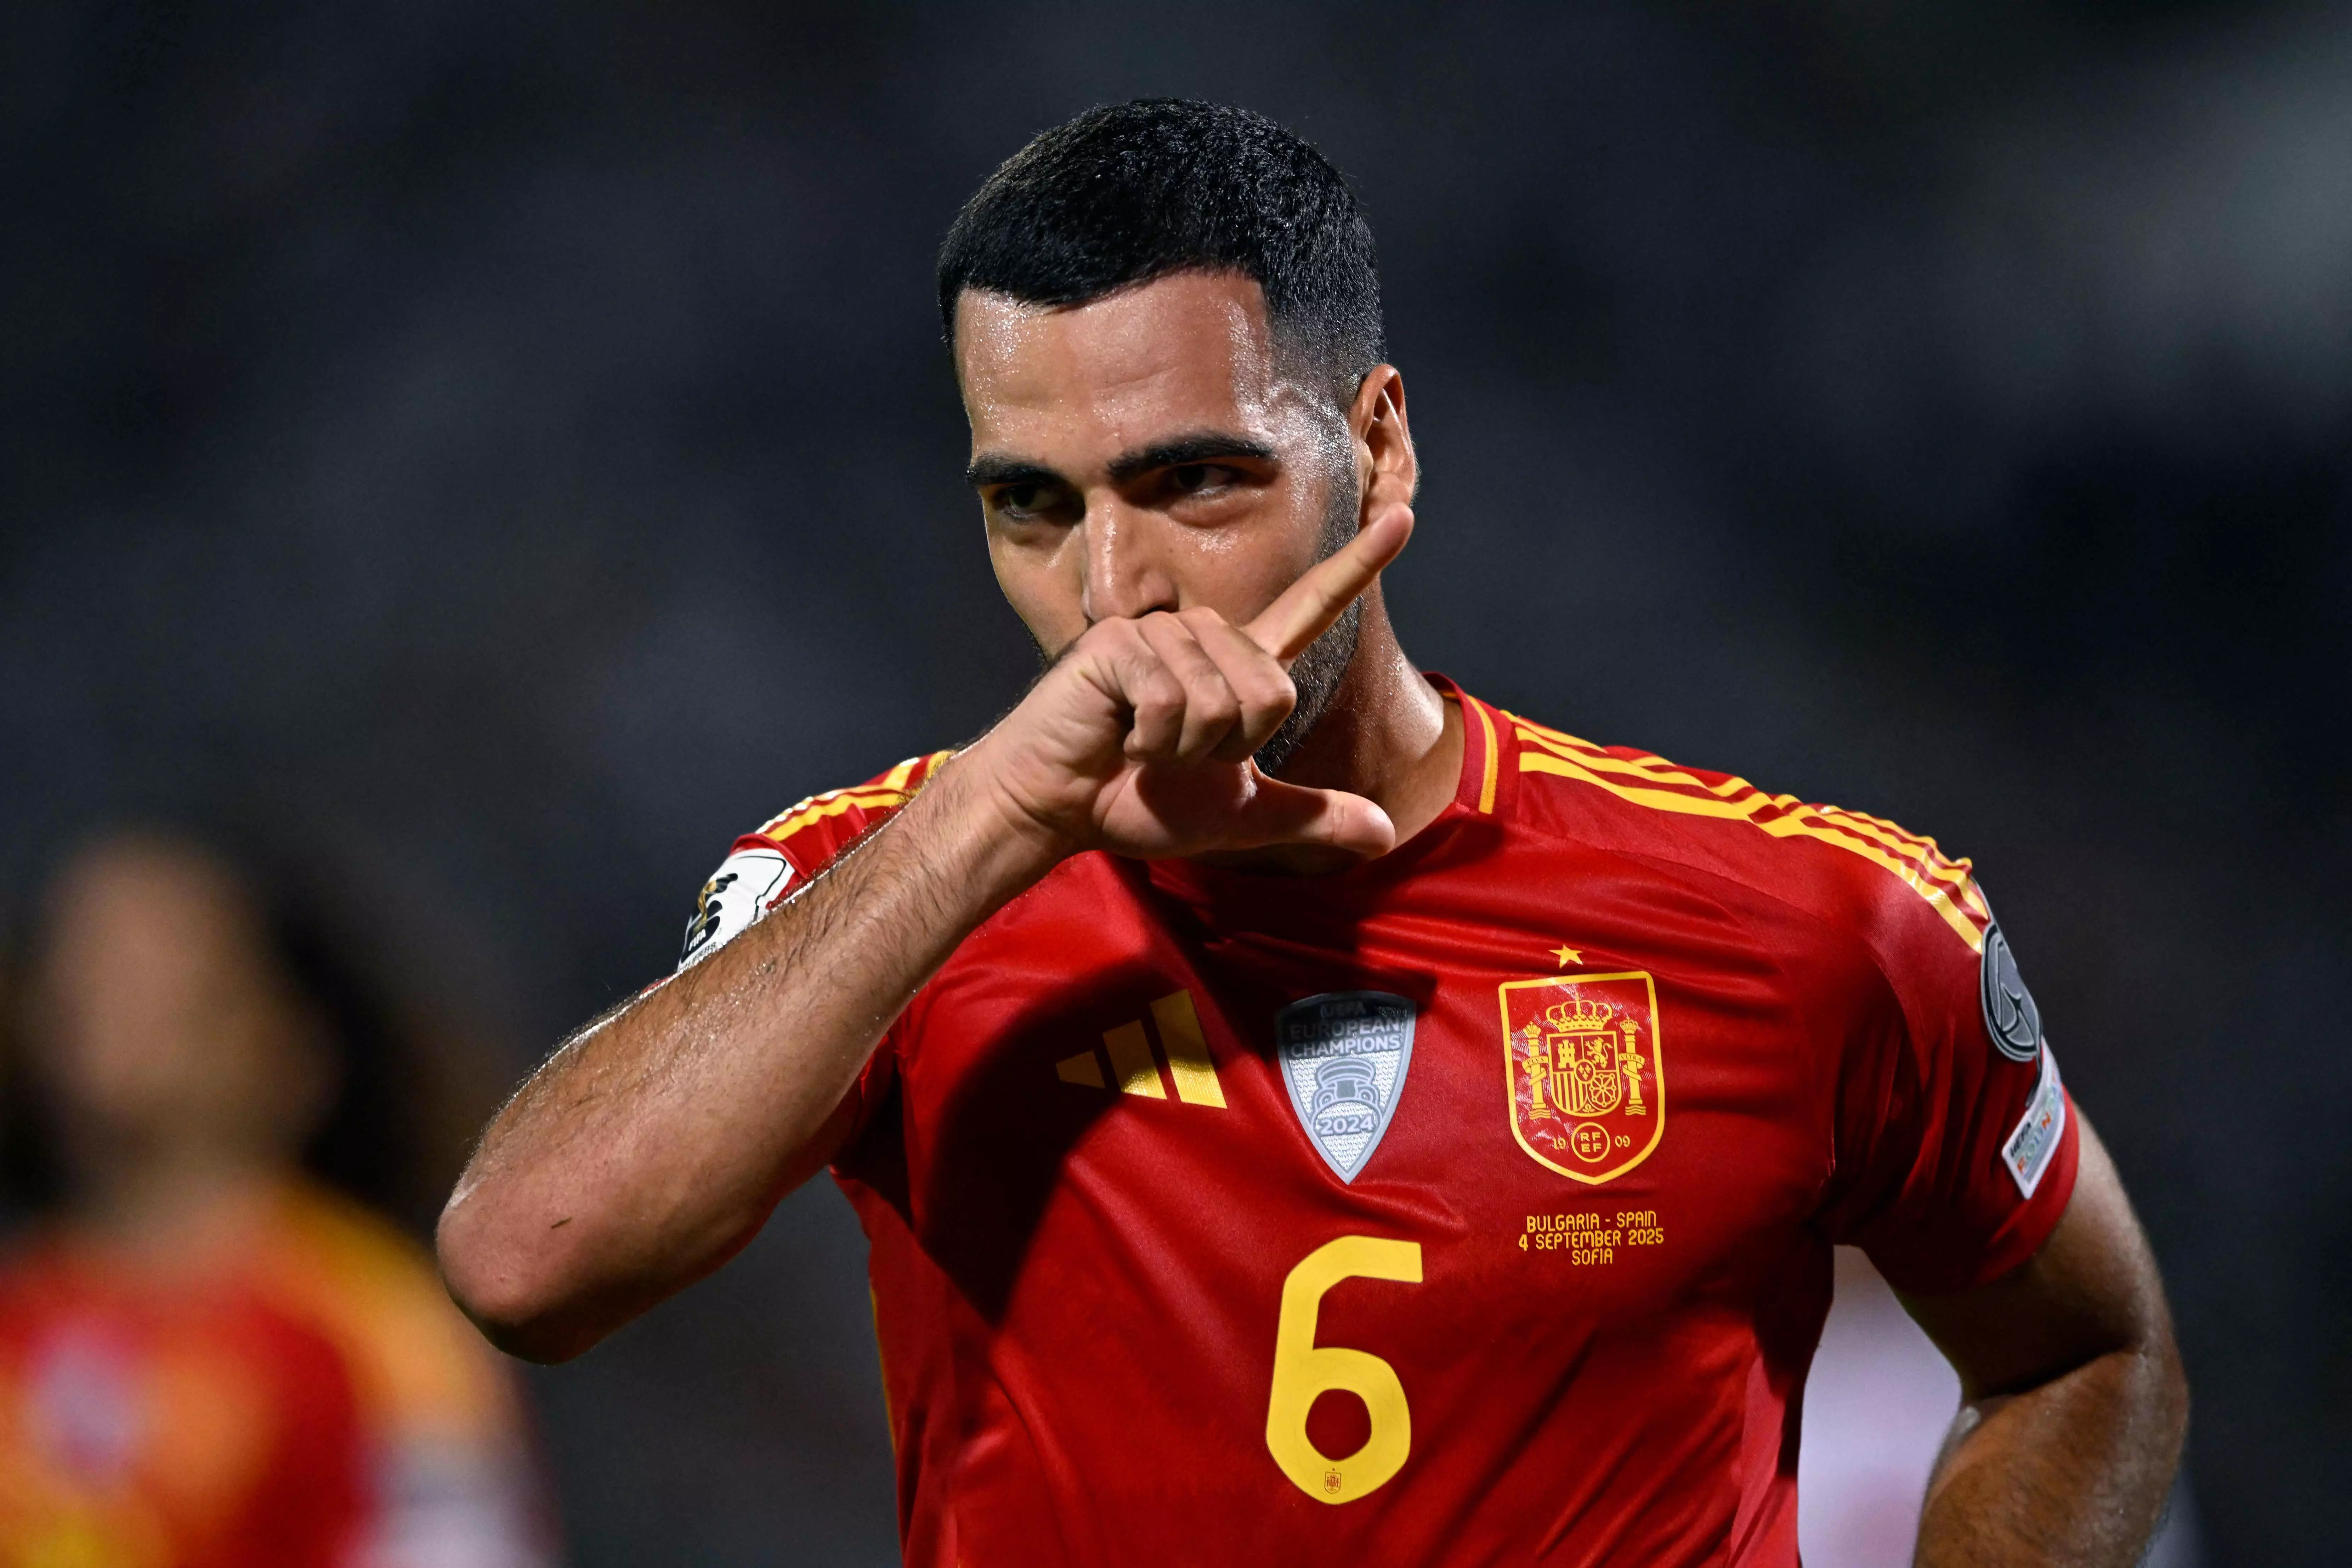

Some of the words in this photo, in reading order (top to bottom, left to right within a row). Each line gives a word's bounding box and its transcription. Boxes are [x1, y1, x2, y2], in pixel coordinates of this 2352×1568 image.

[1290, 1017, 1400, 1040] EUROPEAN
[1290, 1035, 1400, 1058] CHAMPIONS
[1320, 1117, 1373, 1134] 2024
[1615, 1135, 1631, 1148] 09
[1526, 1213, 1600, 1233] BULGARIA
[1616, 1210, 1657, 1228] SPAIN
[1518, 1234, 1529, 1251] 4
[1535, 1230, 1621, 1250] SEPTEMBER
[1628, 1227, 1664, 1246] 2025
[1571, 1248, 1613, 1266] SOFIA
[1265, 1234, 1423, 1505] 6
